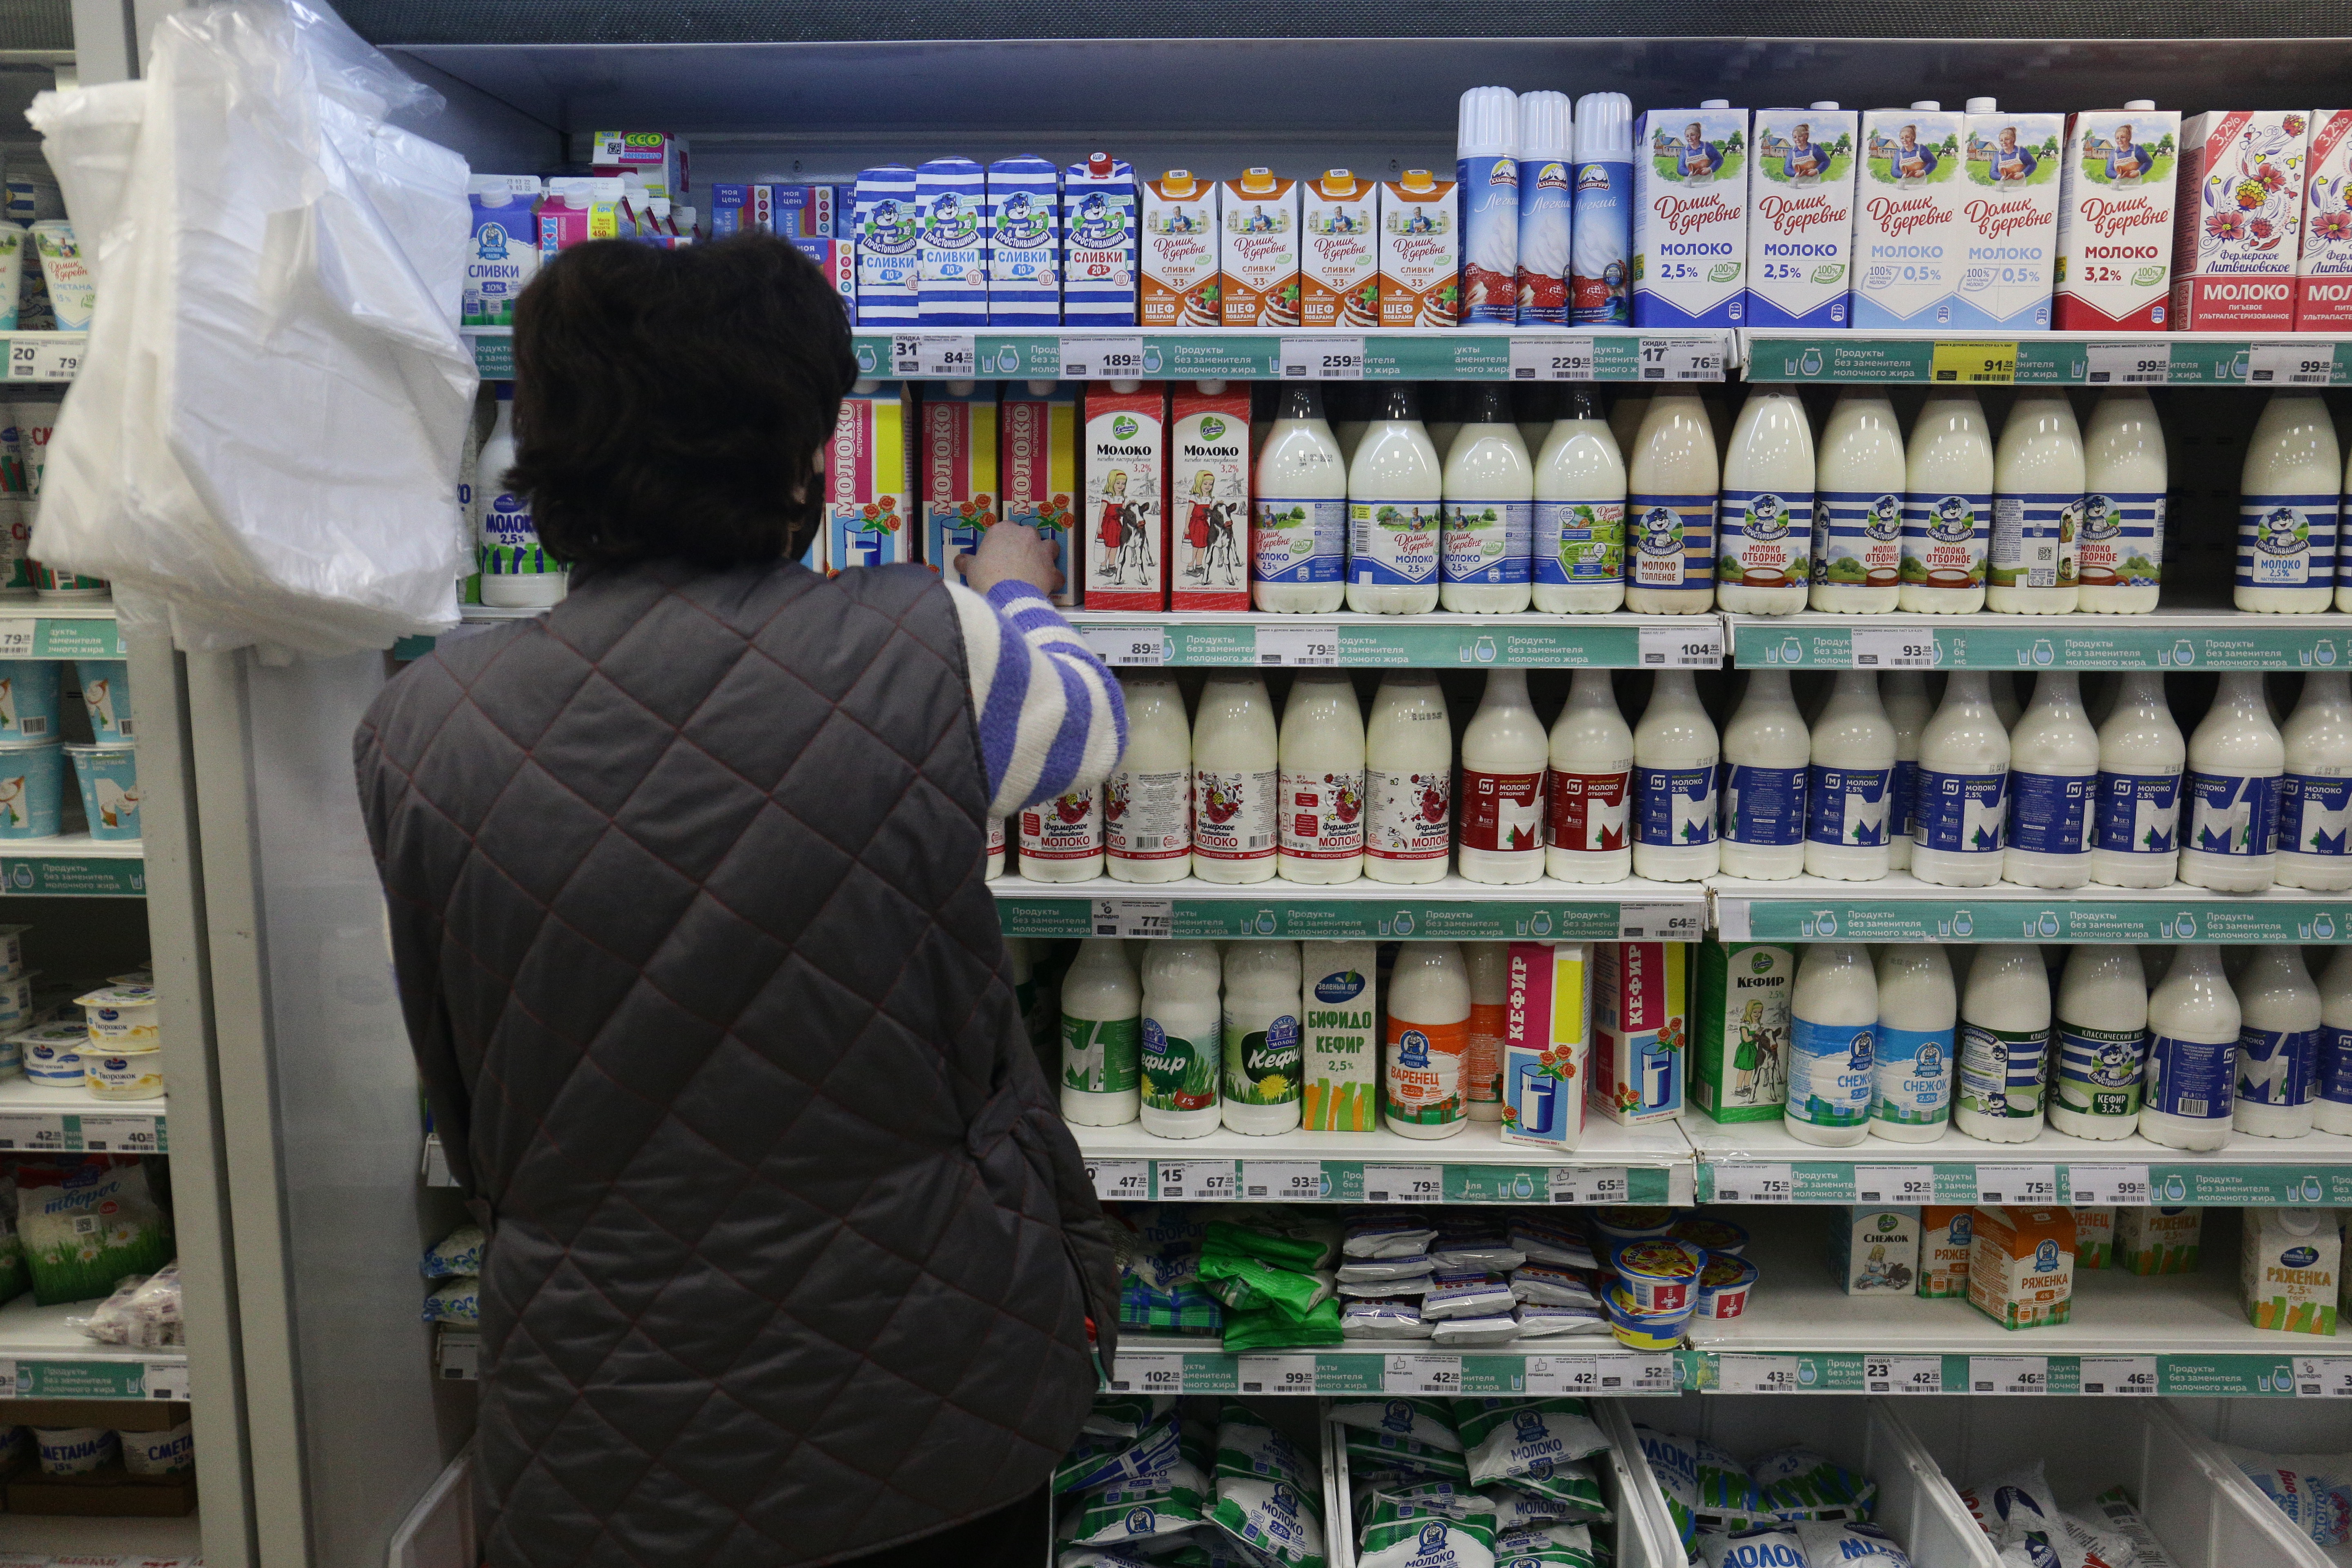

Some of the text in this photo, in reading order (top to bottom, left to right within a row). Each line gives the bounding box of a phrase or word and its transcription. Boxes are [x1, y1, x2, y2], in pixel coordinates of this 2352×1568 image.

[1759, 195, 1826, 219] Домик
[1866, 196, 1932, 220] Домик
[2080, 196, 2147, 220] Домик
[1881, 208, 1953, 236] в деревне
[2095, 208, 2169, 238] в деревне
[997, 233, 1048, 248] ПРОСТОКВАШИНО
[1073, 233, 1124, 248] ПРОСТОКВАШИНО
[1661, 243, 1733, 255] МОЛОКО
[1764, 244, 1837, 256] МОЛОКО
[1871, 246, 1943, 258] МОЛОКО
[1969, 248, 2042, 260] МОЛОКО
[2085, 246, 2158, 259] МОЛОКО
[927, 252, 974, 262] СЛИВКИ
[998, 252, 1046, 262] СЛИВКИ
[1074, 252, 1122, 262] СЛИВКИ
[2220, 250, 2278, 261] Фермерское
[867, 257, 913, 267] СЛИВКИ
[469, 265, 519, 278] СЛИВКИ
[946, 265, 960, 274] 10%
[1018, 265, 1031, 274] 10%
[1092, 265, 1107, 274] 20%
[1661, 264, 1698, 278] 2,5%
[1714, 264, 1734, 273] 100%
[1764, 264, 1801, 278] 2,5%
[2206, 261, 2290, 274] Литвиновское
[969, 274, 980, 283] ГОСТ
[1116, 274, 1128, 283] ГОСТ
[1904, 267, 1941, 281] 0,5%
[2002, 268, 2039, 282] 0,5%
[2085, 267, 2121, 282] 3,2%
[2204, 285, 2289, 301] МОЛОКО
[1145, 304, 1174, 314] ШЕФ
[1305, 304, 1334, 314] ШЕФ
[944, 352, 963, 363] 84
[1835, 349, 1884, 358] Продукты
[1103, 354, 1131, 366] 189
[1323, 356, 1352, 367] 259
[1552, 357, 1581, 368] 229
[1691, 357, 1710, 368] 76
[1854, 360, 1910, 368] заменителя
[1984, 360, 2002, 371] 91
[2137, 361, 2156, 372] 99
[1833, 369, 1915, 378] молочного жира
[933, 404, 952, 515] МОЛОКО
[1013, 404, 1031, 515] МОЛОКО
[1134, 464, 1151, 472] 3,2%
[1221, 465, 1238, 473] 3,2%
[1749, 545, 1780, 553] МОЛОКО
[1934, 546, 1965, 555] МОЛОКО
[1396, 555, 1432, 563] МОЛОКО
[1445, 554, 1480, 562] МОЛОКО
[1743, 552, 1786, 562] ОТБОРНОЕ
[1927, 554, 1970, 564] ОТБОРНОЕ
[1642, 561, 1676, 571] МОЛОКО
[2261, 560, 2300, 569] МОЛОКО
[1131, 644, 1151, 654] 89
[1307, 644, 1327, 655] 79
[1682, 644, 1709, 655] 104
[1903, 646, 1922, 656] 93
[1044, 822, 1087, 831] Фермерское
[1042, 836, 1090, 846] МОЛОКО
[1196, 837, 1238, 847] МОЛОКО
[1319, 835, 1361, 846] МОЛОКО
[1142, 916, 1159, 927] 77
[1668, 918, 1686, 928] 64
[1629, 944, 1642, 1026] КЕФИР
[1737, 977, 1784, 988] КЕФИР
[1509, 956, 1527, 1041] КЕФИР
[1308, 1011, 1371, 1029] БИФИДО
[2082, 1029, 2131, 1040] КЛАССИЧЕСКИЙ
[1316, 1036, 1364, 1054] КЕФИР
[100, 1072, 136, 1081] Творожок
[1391, 1066, 1439, 1086] ВАРЕНЕЦ
[2098, 1094, 2126, 1104] КЕФИР
[2102, 1104, 2121, 1113] 3,2%
[1120, 1176, 1137, 1187] 47
[1206, 1176, 1223, 1187] 67
[1292, 1177, 1310, 1187] 93
[2196, 1175, 2242, 1184] Продукты
[1412, 1182, 1431, 1192] 79
[1597, 1180, 1615, 1190] 65
[1762, 1181, 1780, 1191] 75
[1904, 1182, 1922, 1192] 92
[2026, 1183, 2044, 1193] 75
[2118, 1183, 2136, 1193] 99
[2022, 1274, 2068, 1289] РЯЖЕНКА
[2267, 1267, 2331, 1286] РЯЖЕНКА
[1145, 1372, 1170, 1382] 102
[1432, 1372, 1449, 1382] 42
[1645, 1368, 1662, 1377] 52
[1767, 1372, 1784, 1381] 43
[1913, 1373, 1931, 1383] 42
[2018, 1373, 2036, 1383] 46
[2128, 1374, 2145, 1383] 46
[40, 1439, 96, 1461] МЕТАНА
[1511, 1439, 1563, 1461] МОЛОКО
[1261, 1500, 1303, 1537] МОЛОКО
